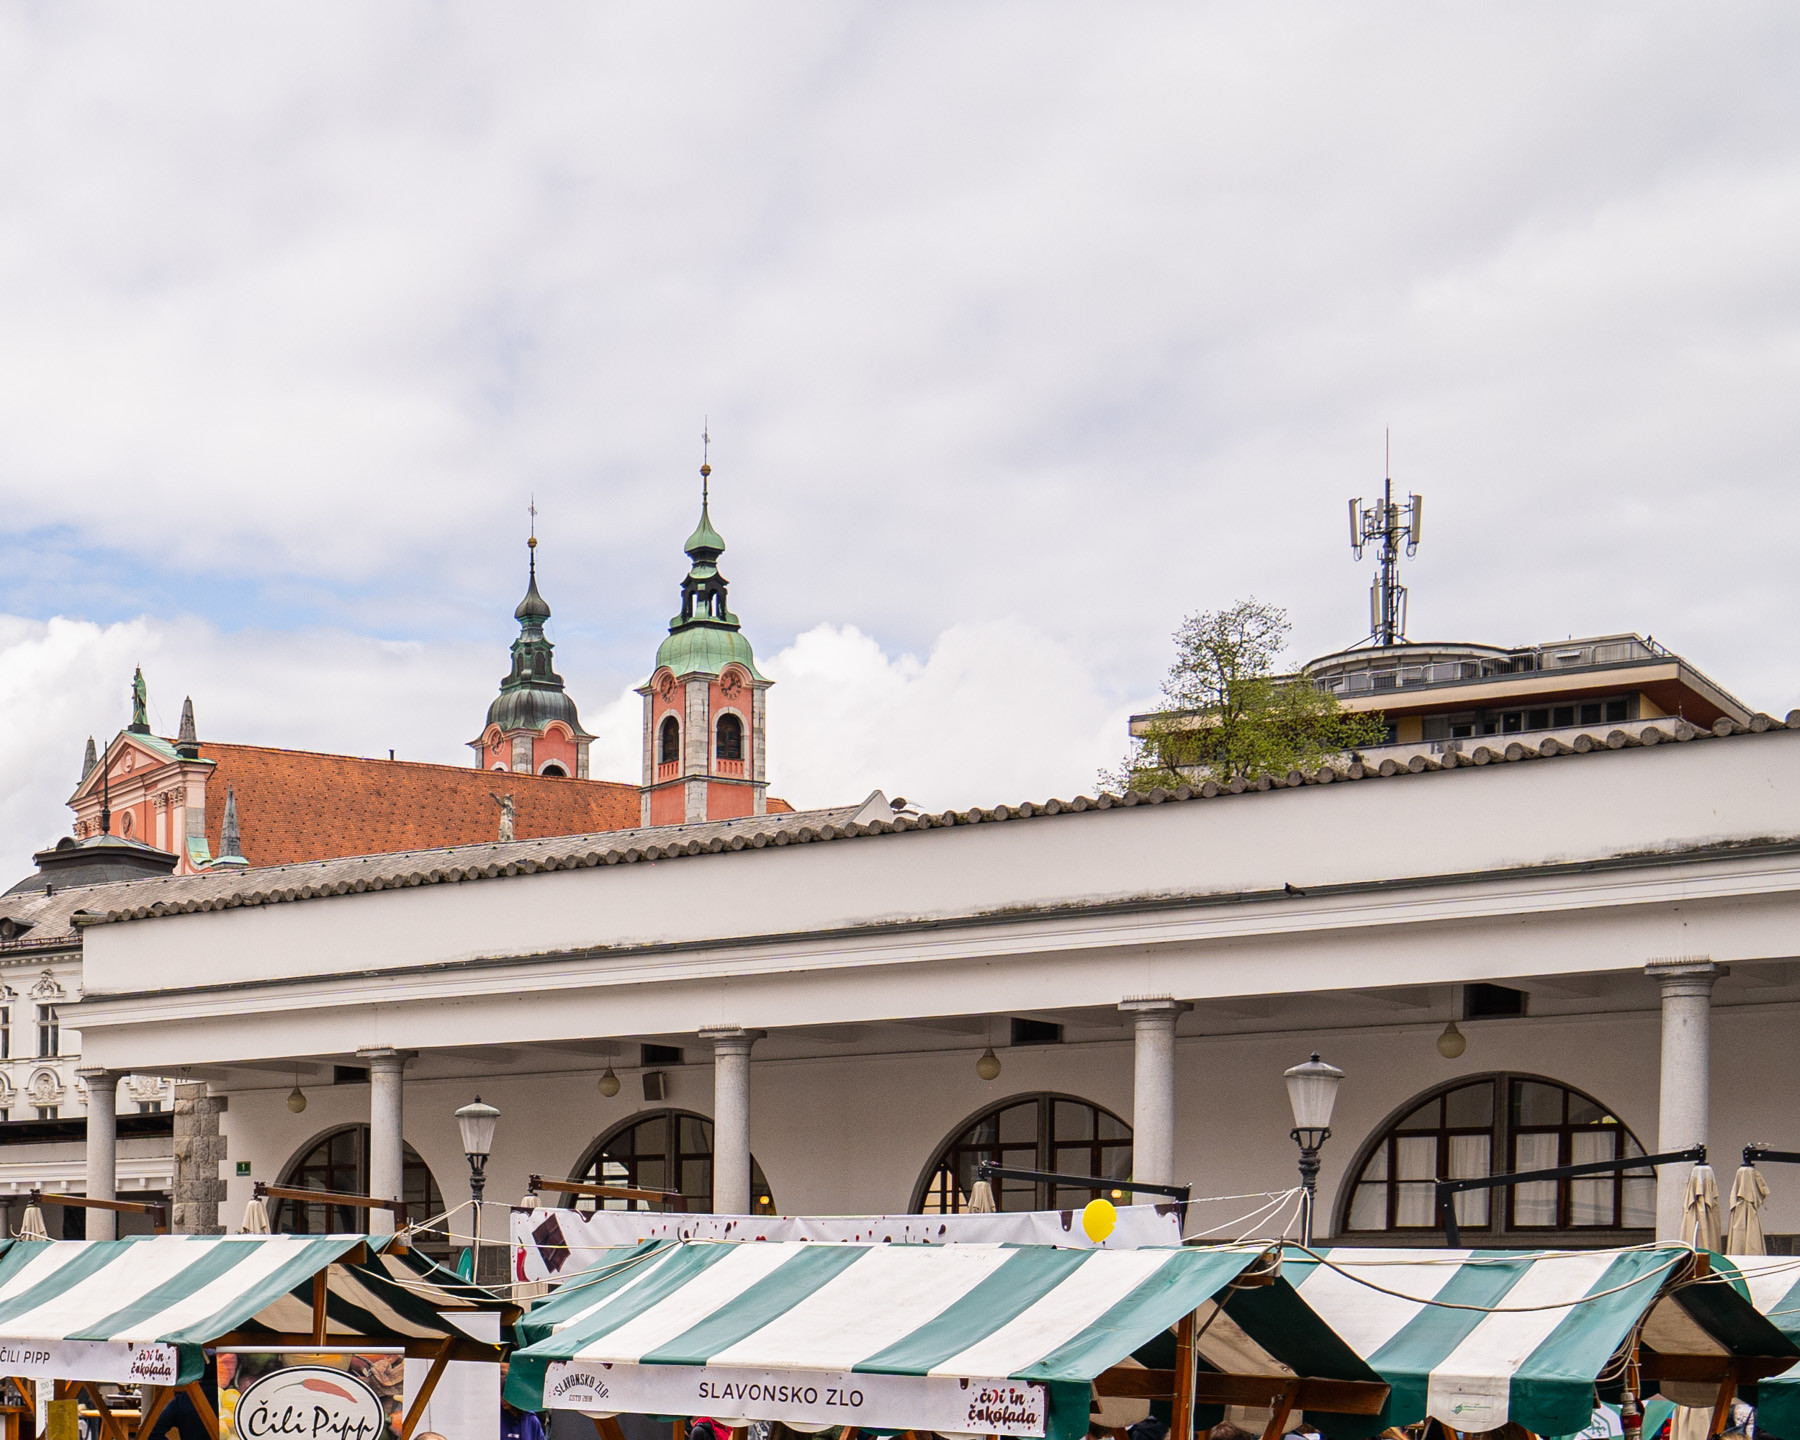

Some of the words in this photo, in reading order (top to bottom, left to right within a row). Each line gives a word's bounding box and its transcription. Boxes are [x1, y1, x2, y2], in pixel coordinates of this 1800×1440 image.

[0, 1346, 20, 1363] ČILI
[23, 1350, 51, 1365] PIPP
[130, 1361, 172, 1378] čokolada
[554, 1373, 596, 1397] SLAVONSKO
[594, 1380, 609, 1399] ZLO
[698, 1382, 818, 1405] SLAVONSKO
[825, 1388, 864, 1408] ZLO
[1009, 1387, 1026, 1406] in
[248, 1400, 307, 1437] Čili
[968, 1403, 1037, 1426] čokolada
